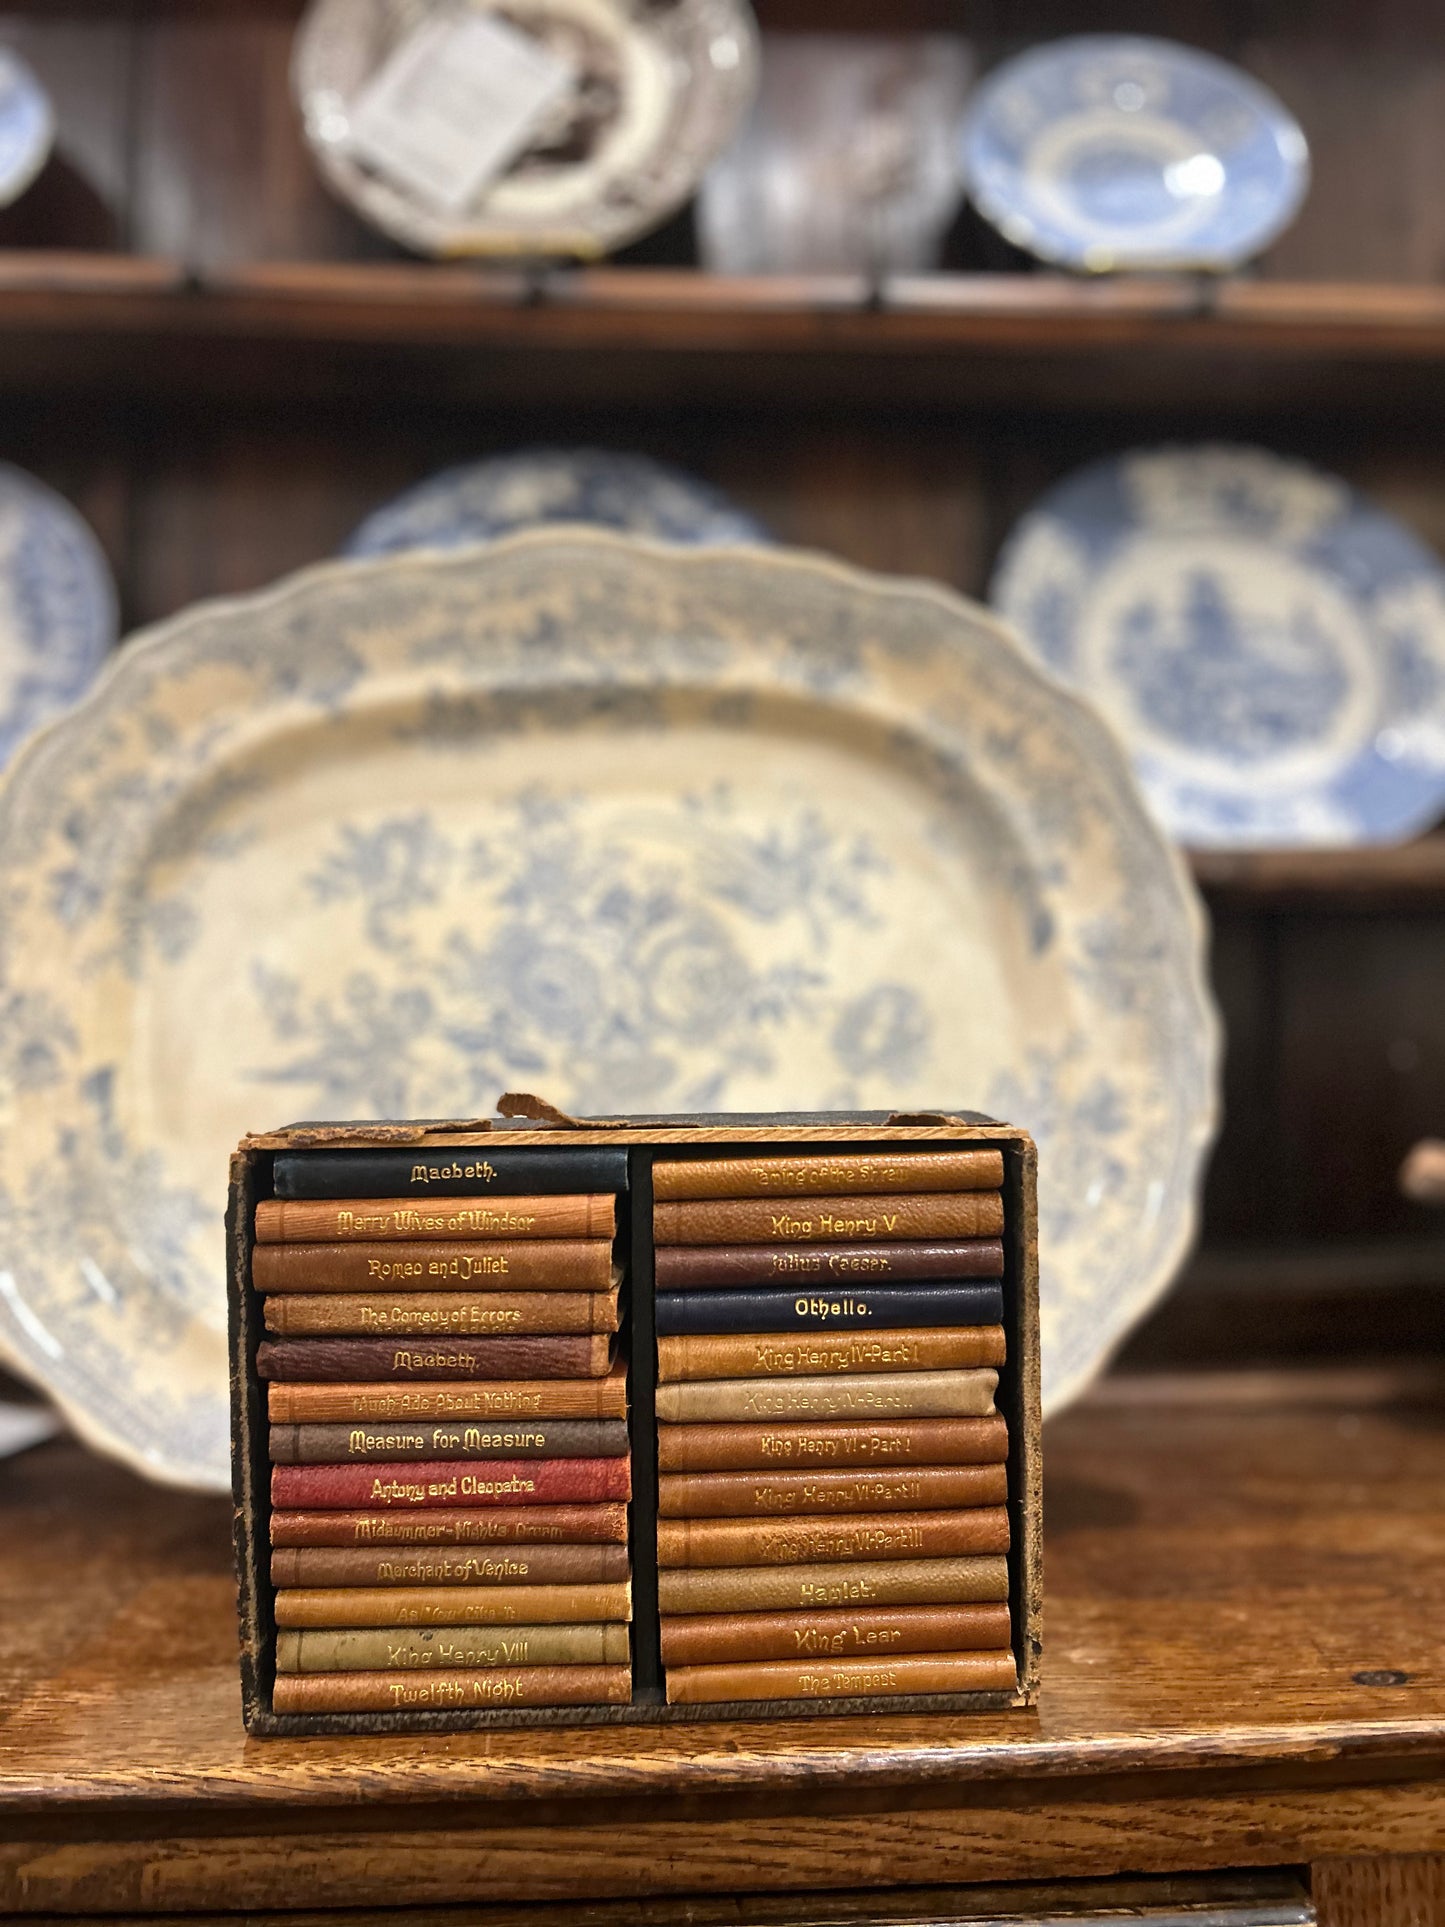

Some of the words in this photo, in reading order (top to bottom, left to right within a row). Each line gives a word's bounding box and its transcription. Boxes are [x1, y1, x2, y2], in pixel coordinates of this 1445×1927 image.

[410, 1161, 498, 1183] Macbeth.
[810, 1166, 829, 1184] of
[829, 1165, 855, 1183] the
[337, 1211, 390, 1235] Merry
[393, 1211, 444, 1231] Wives
[447, 1211, 468, 1231] of
[467, 1210, 536, 1232] Windsor
[771, 1214, 813, 1239] King
[819, 1214, 877, 1237] Henry
[882, 1214, 898, 1232] V
[367, 1259, 423, 1281] Romeo
[428, 1257, 459, 1279] and
[460, 1256, 509, 1280] Juliet
[360, 1307, 388, 1326] The
[390, 1307, 449, 1326] Comedy
[450, 1307, 468, 1323] of
[470, 1306, 524, 1324] Errors
[794, 1298, 873, 1320] Othello.
[753, 1346, 796, 1371] King
[797, 1346, 850, 1369] Henry
[434, 1393, 481, 1414] About
[482, 1392, 542, 1413] Nothing
[348, 1430, 424, 1453] Measure
[432, 1429, 460, 1449] for
[462, 1429, 546, 1451] Measure
[761, 1436, 792, 1457] King
[797, 1437, 839, 1457] Henry
[370, 1479, 425, 1503] Antony
[428, 1477, 457, 1500] and
[461, 1474, 536, 1500] Cleopatra
[377, 1562, 451, 1581] Merchant
[454, 1560, 472, 1581] of
[471, 1558, 528, 1580] Venice
[794, 1628, 847, 1653] King
[852, 1625, 901, 1645] Lear
[387, 1645, 433, 1666] King
[439, 1644, 499, 1667] Henry
[501, 1641, 529, 1663] VIII
[390, 1682, 465, 1706] Twelfth
[473, 1675, 524, 1703] Night
[798, 1675, 830, 1694] The
[833, 1671, 897, 1694] Tempest
